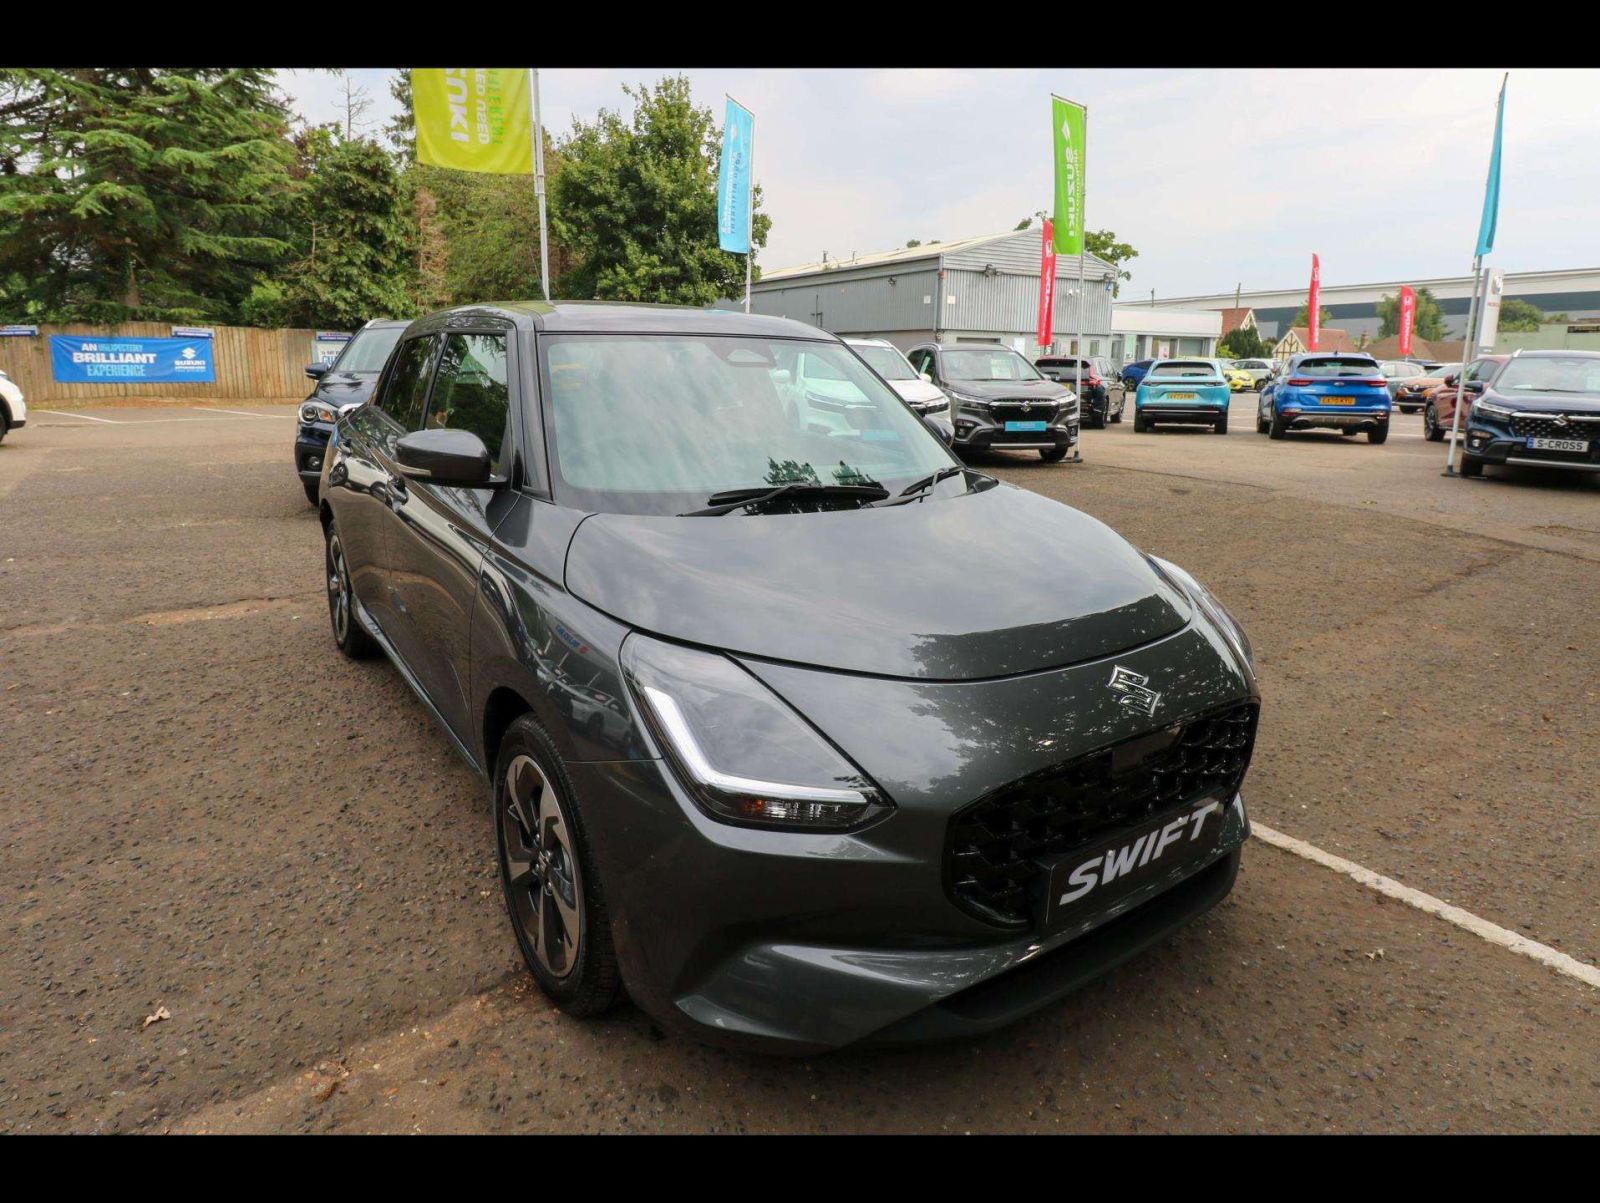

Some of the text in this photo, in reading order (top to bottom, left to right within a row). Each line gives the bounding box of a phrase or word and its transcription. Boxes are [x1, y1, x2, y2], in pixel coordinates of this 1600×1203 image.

[81, 343, 97, 351] AN
[72, 352, 157, 364] BRILLIANT
[86, 364, 147, 377] EXPERIENCE
[1537, 439, 1584, 451] S-CROSS
[1058, 800, 1221, 906] SWIFT
